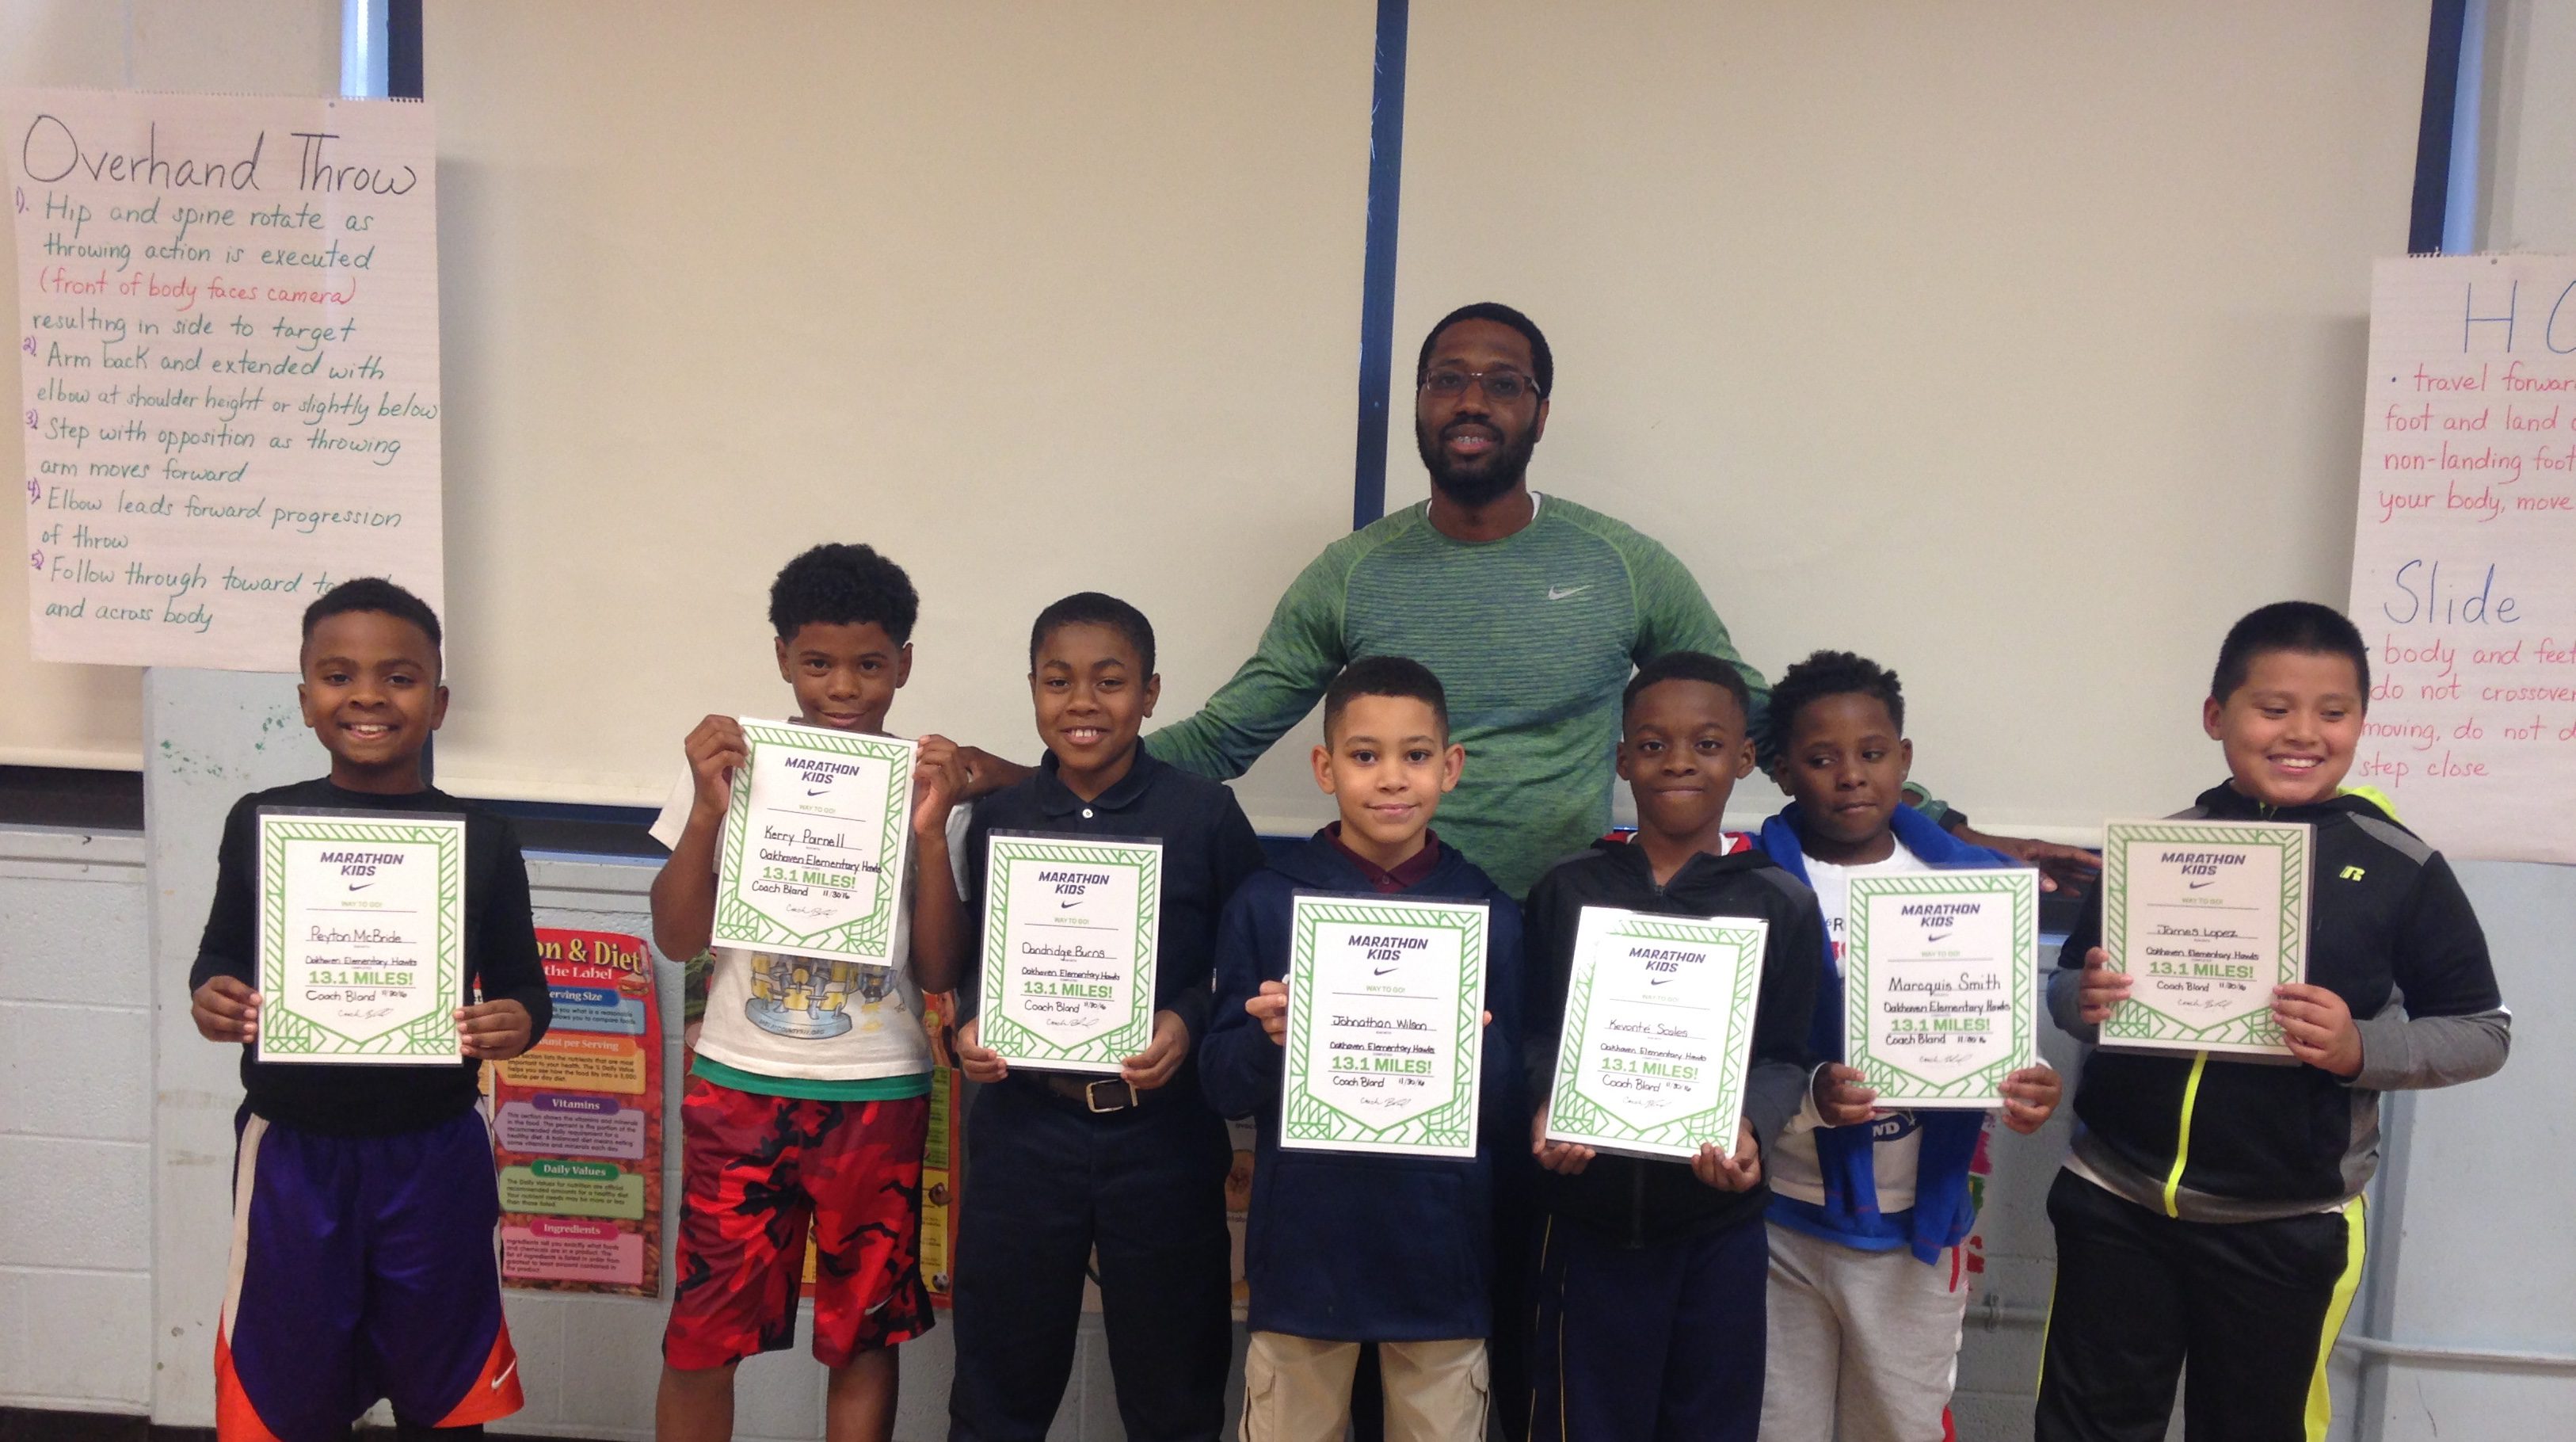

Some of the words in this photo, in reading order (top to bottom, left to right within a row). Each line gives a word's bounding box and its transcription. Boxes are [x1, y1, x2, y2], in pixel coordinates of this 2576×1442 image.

[24, 115, 264, 191] Overhand
[291, 133, 417, 194] Throw
[47, 191, 91, 239] Hip
[110, 197, 160, 224] and
[173, 208, 234, 241] spine
[251, 203, 324, 229] rotate
[346, 216, 373, 231] as
[44, 233, 130, 272] throwing
[146, 236, 211, 261] action
[227, 246, 244, 263] is
[261, 239, 375, 269] executed
[40, 266, 108, 294] (front
[120, 273, 142, 296] of
[149, 273, 196, 311] body
[208, 277, 257, 299] faces
[268, 277, 356, 304] camera)
[33, 307, 126, 343] resulting
[139, 319, 158, 334] in
[173, 314, 213, 334] side
[231, 315, 253, 336] to
[272, 317, 356, 351] target
[48, 341, 90, 367] Arm
[102, 342, 149, 368] back
[161, 347, 202, 371] and
[212, 349, 323, 375] extended
[330, 356, 384, 379] with
[2414, 363, 2486, 392] travel
[2502, 360, 2576, 392] forwar
[37, 377, 90, 402] elbow
[98, 384, 120, 404] at
[127, 384, 199, 406] shoulder
[205, 385, 264, 422] height
[273, 401, 291, 412] or
[299, 392, 369, 425] slightly
[378, 391, 437, 419] below
[2386, 403, 2434, 431] foot
[2443, 408, 2488, 430] and
[2506, 405, 2559, 431] land
[45, 418, 90, 448] Step
[101, 420, 146, 441] with
[158, 423, 255, 453] opposition
[270, 437, 292, 448] as
[307, 429, 400, 466] throwing
[40, 461, 78, 475] arm
[90, 464, 149, 475] moves
[162, 458, 249, 483] forward
[2384, 441, 2521, 485] non-landing
[2534, 446, 2576, 471] foot
[48, 486, 102, 510] Elbow
[119, 490, 173, 516] leads
[185, 498, 265, 517] forward
[271, 508, 402, 533] progression
[2379, 490, 2435, 523] your
[2448, 479, 2506, 523] body,
[2517, 495, 2574, 511] move
[42, 524, 63, 544] of
[73, 525, 128, 548] throw
[51, 556, 115, 582] Follow
[125, 562, 207, 597] through
[223, 566, 303, 592] toward
[2384, 559, 2521, 624] Slide
[46, 597, 85, 617] and
[96, 605, 153, 620] across
[164, 596, 213, 633] body
[2384, 634, 2455, 677] body
[2473, 640, 2521, 665] and
[2370, 675, 2403, 700] do
[2422, 673, 2460, 700] not
[2361, 719, 2441, 751] moving,
[2454, 718, 2483, 740] do
[2505, 715, 2547, 741] not
[785, 757, 859, 776] MARATHON
[2359, 752, 2409, 788] step
[2427, 751, 2489, 776] close
[802, 771, 833, 784] KIDS
[764, 826, 795, 846] Kerry
[803, 829, 844, 848] Parnell
[320, 852, 404, 865] MARATHON
[760, 849, 804, 864] Oakhaven
[806, 854, 859, 875] Elementary
[2161, 853, 2246, 864] MARATHON
[341, 865, 376, 876] KIDS
[763, 866, 798, 882] 13.1
[802, 872, 855, 889] MILES!
[1038, 872, 1109, 885] MARATHON
[2181, 864, 2217, 876] KIDS
[753, 881, 780, 893] Coach
[783, 884, 808, 896] Bland
[1055, 884, 1085, 895] KIDS
[1901, 904, 1980, 916] MARATHON
[1921, 917, 1953, 927] KIDS
[311, 925, 350, 944] Peyton
[355, 929, 402, 943] McBride
[1348, 935, 1428, 950] MARATHON
[569, 939, 588, 962] &
[594, 941, 642, 974] Diet
[1076, 946, 1104, 958] Burns
[1367, 949, 1400, 960] KIDS
[1629, 948, 1705, 963] MARATHON
[545, 965, 570, 976] the
[573, 967, 612, 979] Label
[1645, 961, 1679, 972] KIDS
[2150, 962, 2188, 975] 13.1
[2193, 963, 2253, 978] MILES!
[309, 971, 348, 984] 13.1
[354, 971, 413, 985] MILES!
[1959, 972, 2000, 990] Smith
[306, 990, 341, 1000] Coach
[345, 990, 376, 1002] Bland
[550, 991, 581, 1001] erving
[583, 992, 602, 1001] Size
[1024, 982, 1057, 994] 13.1
[1062, 983, 1112, 998] MILES!
[1025, 1000, 1053, 1011] Coach
[1056, 1001, 1080, 1013] Bland
[1332, 1016, 1391, 1028] Johnathan
[1397, 1019, 1427, 1031] Wilson
[1892, 1019, 1929, 1032] 13.1
[1934, 1018, 1990, 1031] MILES!
[564, 1040, 581, 1048] per
[582, 1040, 619, 1051] Serving
[1886, 1033, 1915, 1045] Coach
[1919, 1033, 1945, 1043] Bland
[1332, 1056, 1370, 1070] 13.1
[1375, 1058, 1432, 1074] MILES!
[1333, 1076, 1358, 1086] Coach
[1361, 1077, 1385, 1087] Bland
[552, 1098, 600, 1109] Vitamins
[544, 1165, 570, 1177] Daily
[572, 1166, 606, 1176] Values
[544, 1224, 600, 1234] Ingredients
